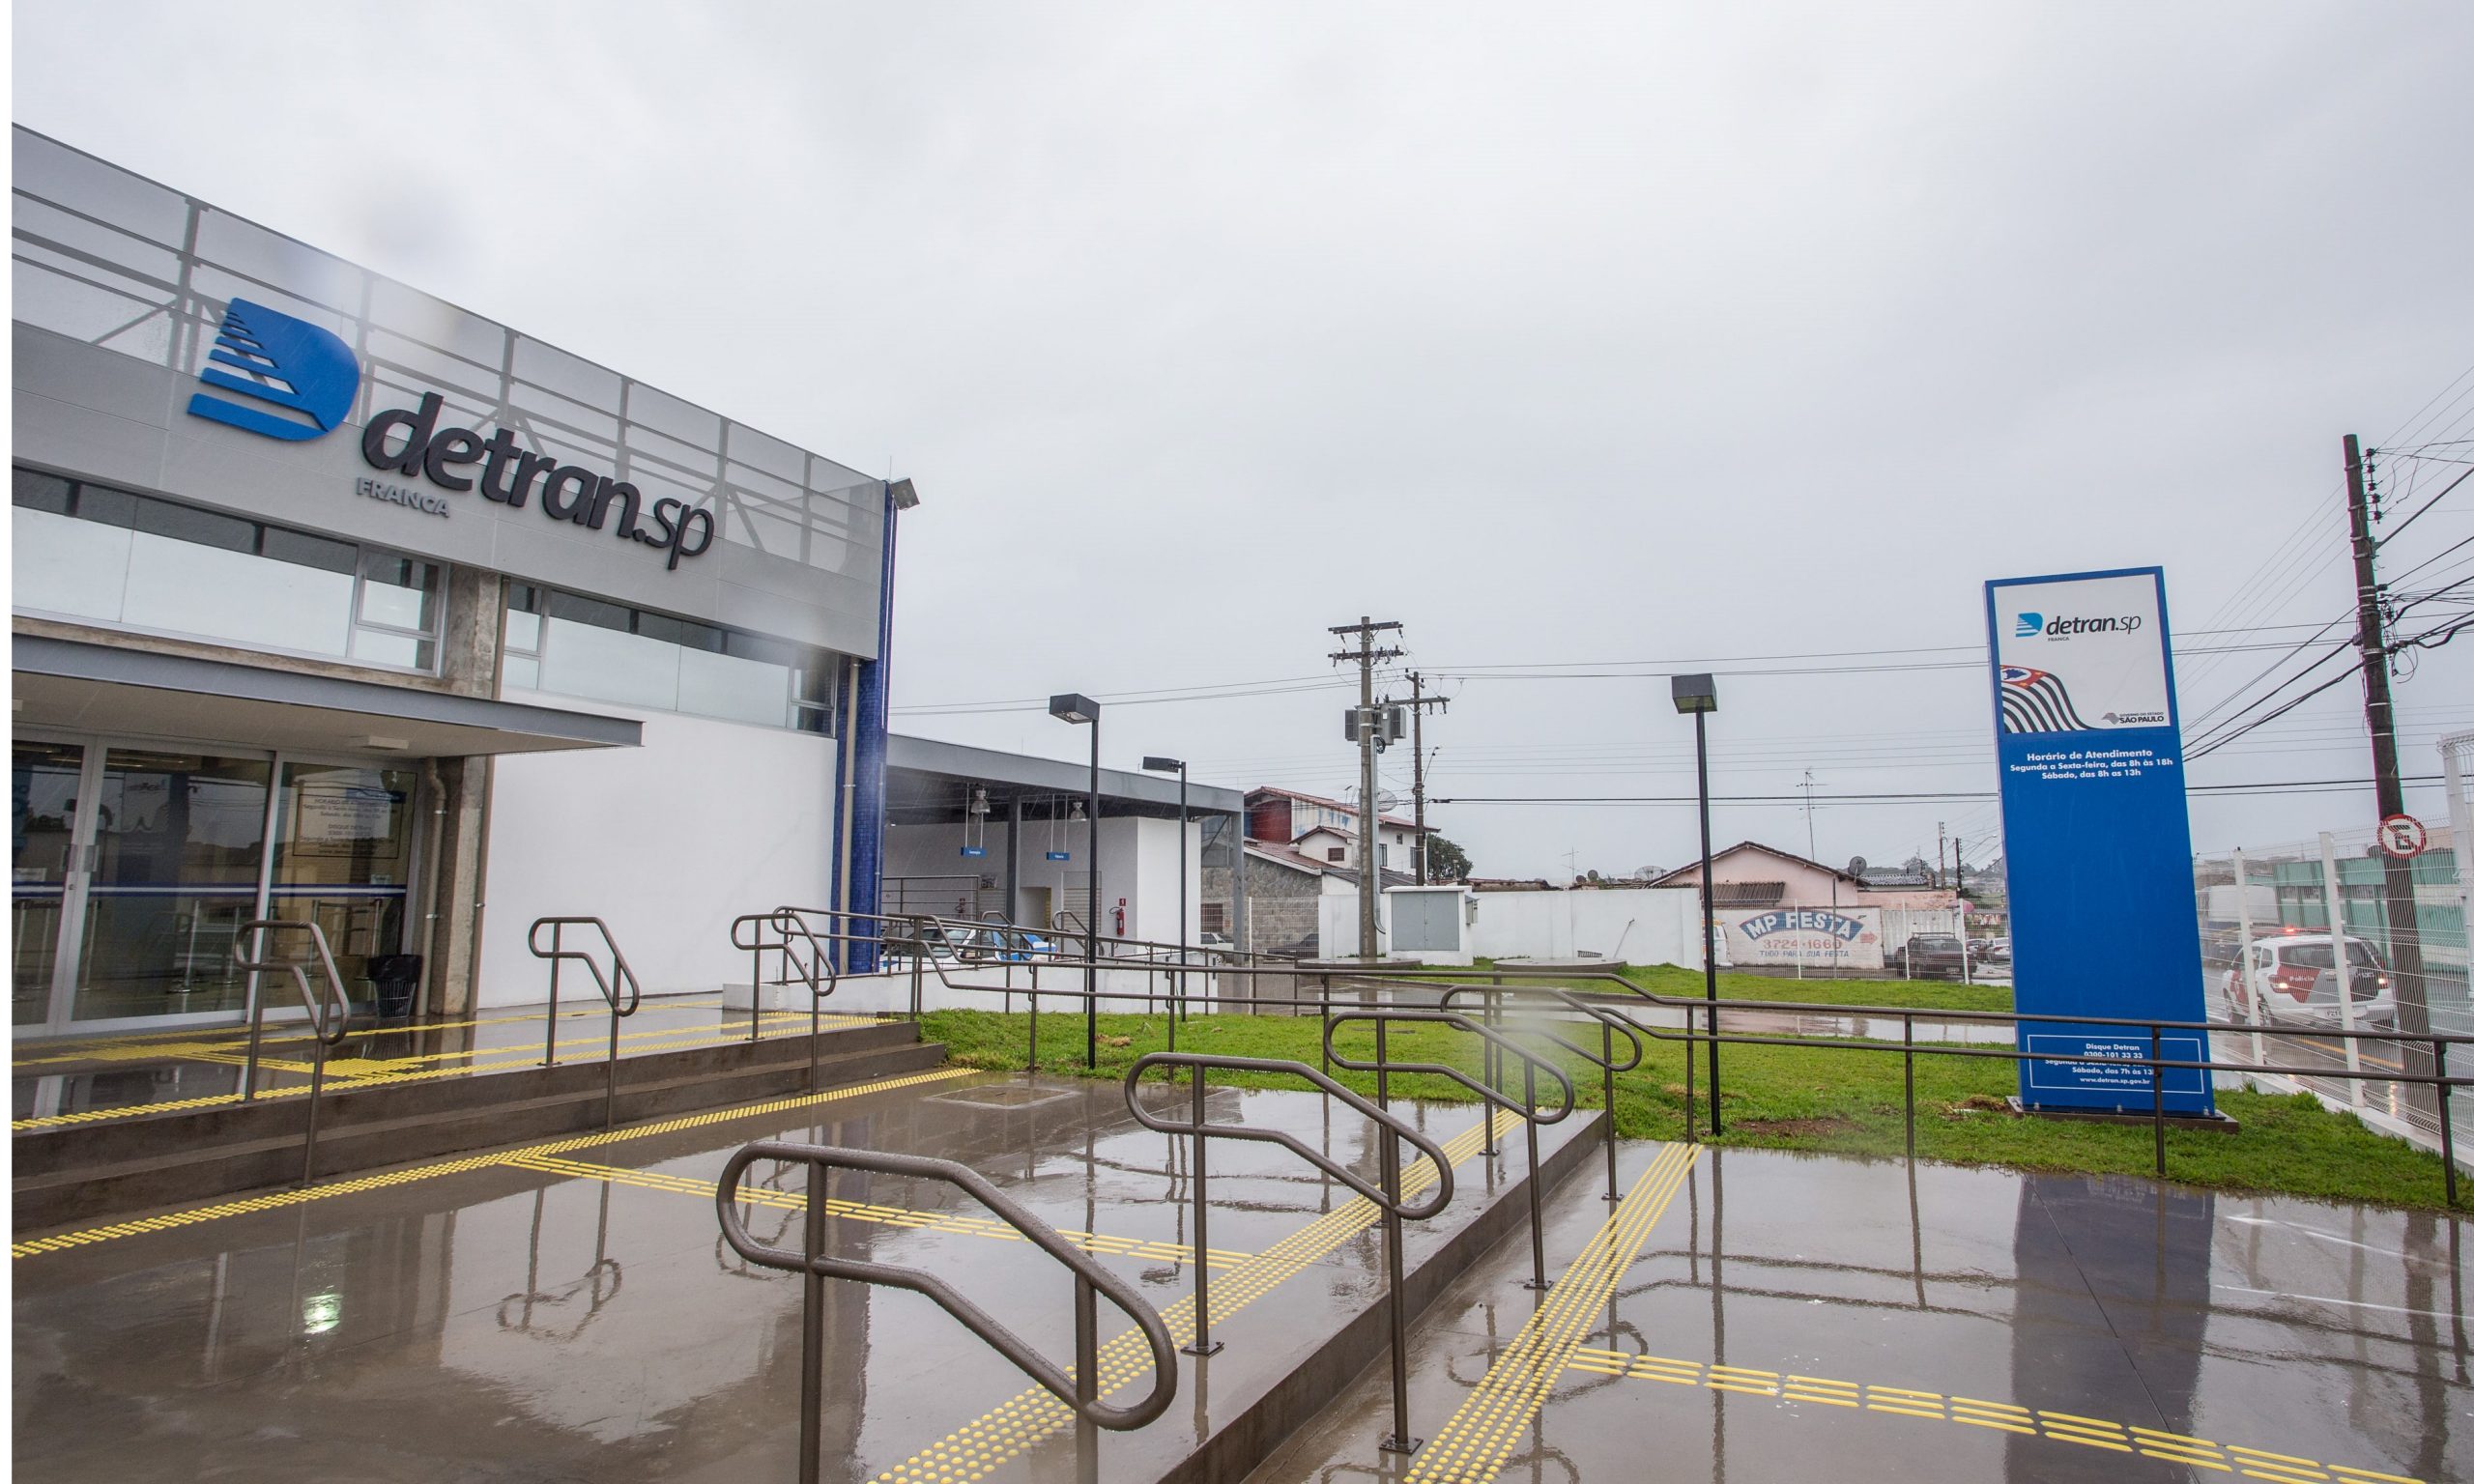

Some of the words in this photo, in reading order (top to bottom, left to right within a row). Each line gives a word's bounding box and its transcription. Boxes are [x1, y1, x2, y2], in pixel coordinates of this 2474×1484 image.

[361, 391, 715, 570] detran.sp
[357, 476, 450, 518] FRANCA
[2046, 615, 2142, 635] detran.sp
[2027, 753, 2066, 761] Horário
[2069, 751, 2083, 759] de
[2085, 750, 2153, 759] Atendimento
[2010, 762, 2048, 772] Segunda
[2057, 760, 2109, 770] Sexta-feira,
[2111, 759, 2127, 768] das
[2041, 770, 2078, 780] Sábado,
[2080, 770, 2095, 779] das
[1745, 914, 1777, 938] MP
[1785, 912, 1852, 938] FESTA
[2086, 1042, 2112, 1051] Disque
